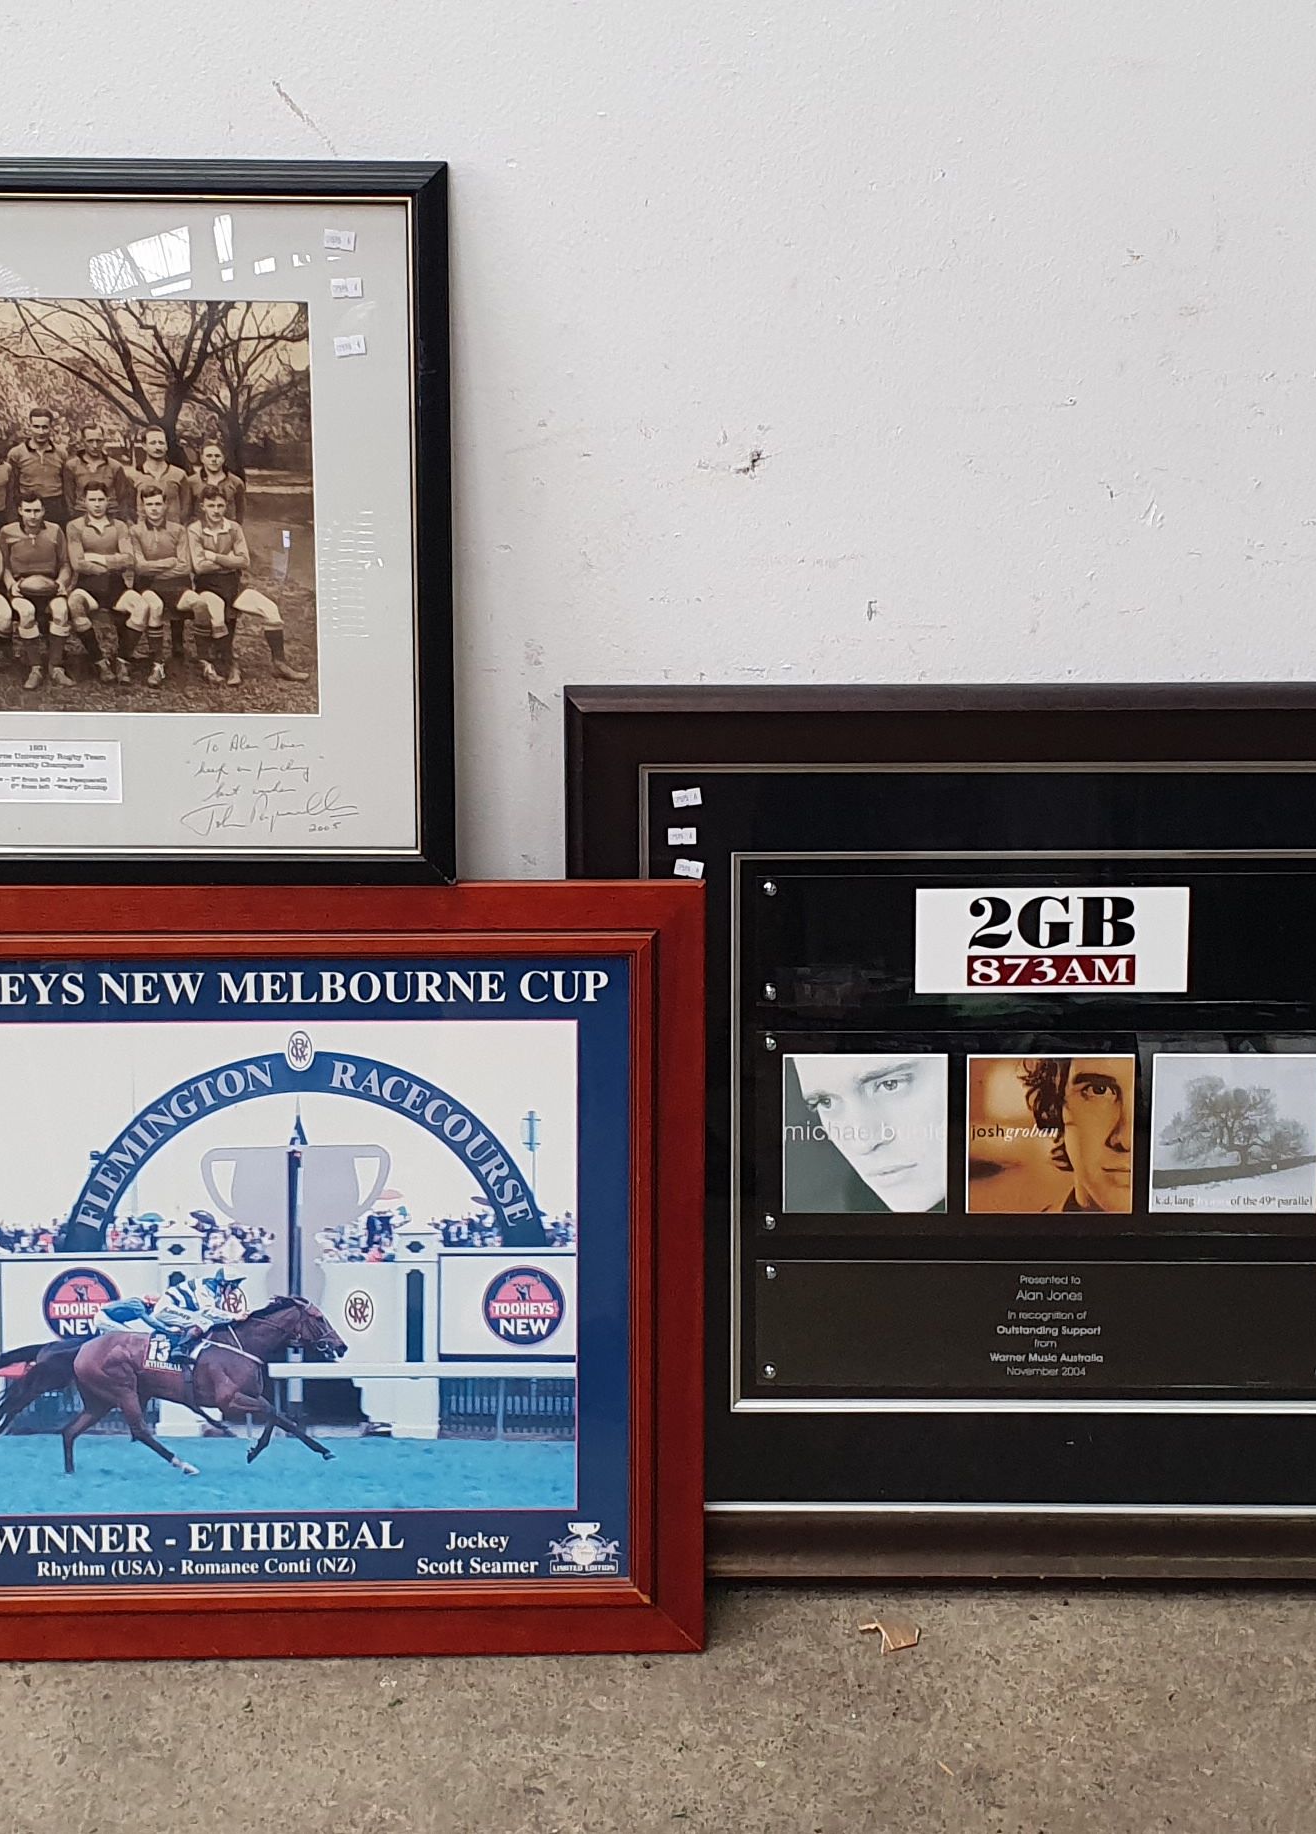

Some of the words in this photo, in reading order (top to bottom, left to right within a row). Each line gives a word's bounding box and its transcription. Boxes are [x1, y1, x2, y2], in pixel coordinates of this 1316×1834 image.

[968, 895, 1137, 950] 2GB
[970, 956, 1133, 985] 873AM
[98, 973, 204, 1005] NEW
[218, 971, 507, 1004] MELBOURNE
[520, 970, 609, 1002] CUP
[971, 1121, 1060, 1143] joshgroban
[74, 1061, 275, 1233] FLEMINGTON
[329, 1059, 534, 1228] RACECOURSE
[1174, 1195, 1195, 1208] lang
[1230, 1195, 1242, 1206] of
[1243, 1196, 1258, 1206] the
[1277, 1195, 1313, 1208] parallel
[1019, 1274, 1069, 1285] Presented
[1070, 1275, 1081, 1285] to
[1015, 1289, 1044, 1301] Alan
[1046, 1289, 1083, 1302] Jones
[53, 1302, 103, 1317] TOOHE
[492, 1302, 554, 1316] TOOHEYS
[1076, 1310, 1088, 1320] of
[499, 1318, 550, 1336] NEW
[996, 1325, 1059, 1337] Outstanding
[1061, 1325, 1102, 1337] Support
[148, 1339, 171, 1362] 13
[1034, 1338, 1058, 1349] from
[989, 1352, 1026, 1362] Warner
[1028, 1352, 1058, 1363] Music
[1059, 1353, 1104, 1363] Australia
[1006, 1366, 1059, 1377] November
[1061, 1366, 1086, 1377] 2004
[189, 1521, 404, 1551] ETHEREAL
[446, 1532, 509, 1552] Jockey
[38, 1561, 105, 1580] Rhythm
[112, 1560, 163, 1577] (USA)
[181, 1560, 259, 1574] Romanee
[265, 1558, 310, 1573] Conti
[317, 1558, 355, 1574] (NZ)
[417, 1558, 463, 1574] Scott
[470, 1557, 538, 1573] Seamer
[552, 1564, 583, 1572] LIMITED
[585, 1564, 616, 1572] EDITION
